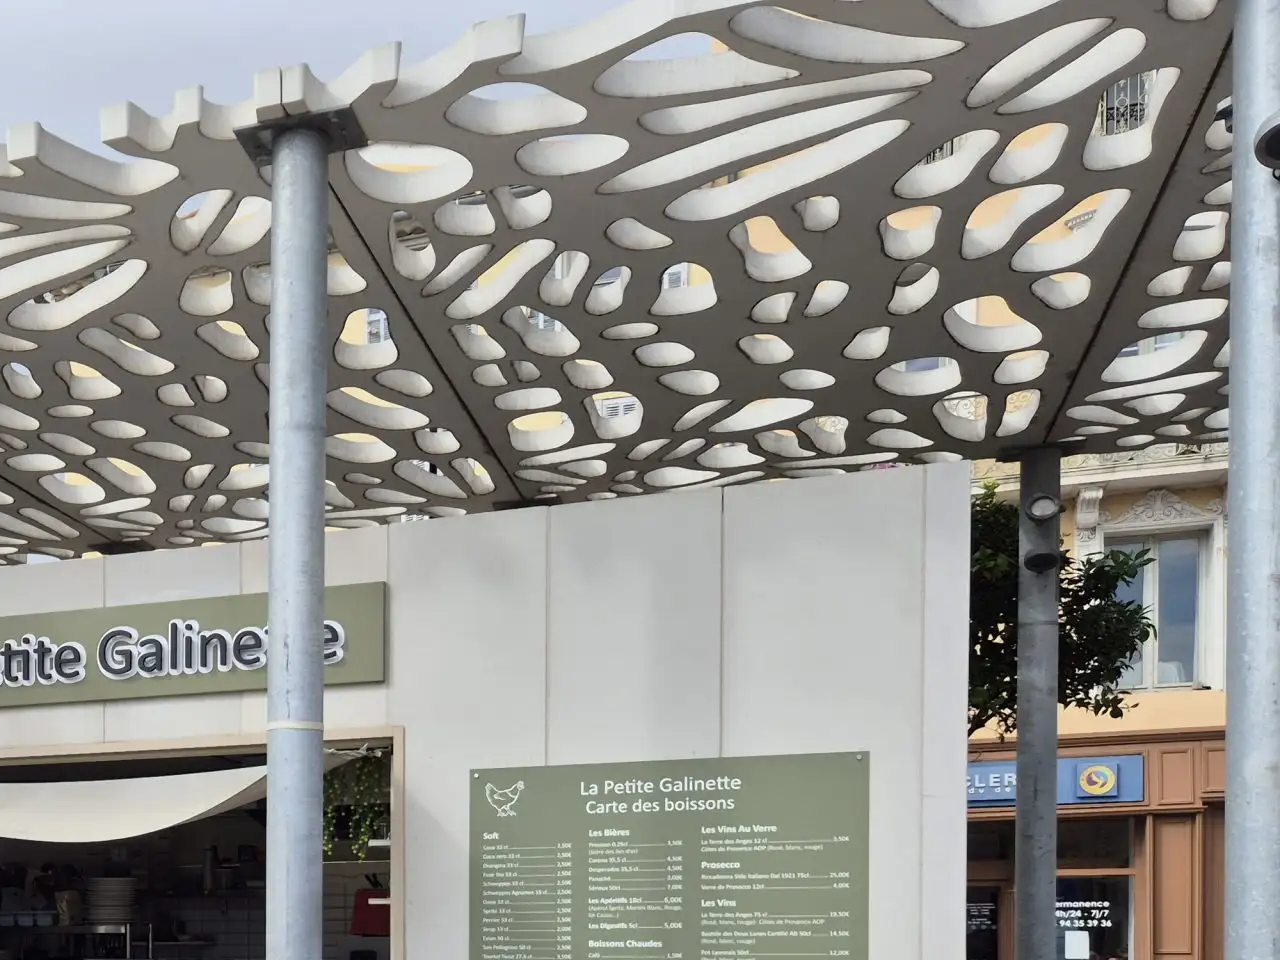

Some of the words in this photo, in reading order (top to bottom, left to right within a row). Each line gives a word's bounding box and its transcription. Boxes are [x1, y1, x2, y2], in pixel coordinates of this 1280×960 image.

[97, 618, 344, 681] Galinee
[581, 782, 598, 795] La
[604, 780, 654, 794] Petite
[660, 776, 741, 792] Galinette
[586, 801, 627, 814] Carte
[632, 799, 659, 812] des
[665, 797, 735, 811] boissons
[702, 826, 715, 834] Les
[1055, 910, 1081, 918] 4h/24
[1091, 910, 1109, 918] 7j/7
